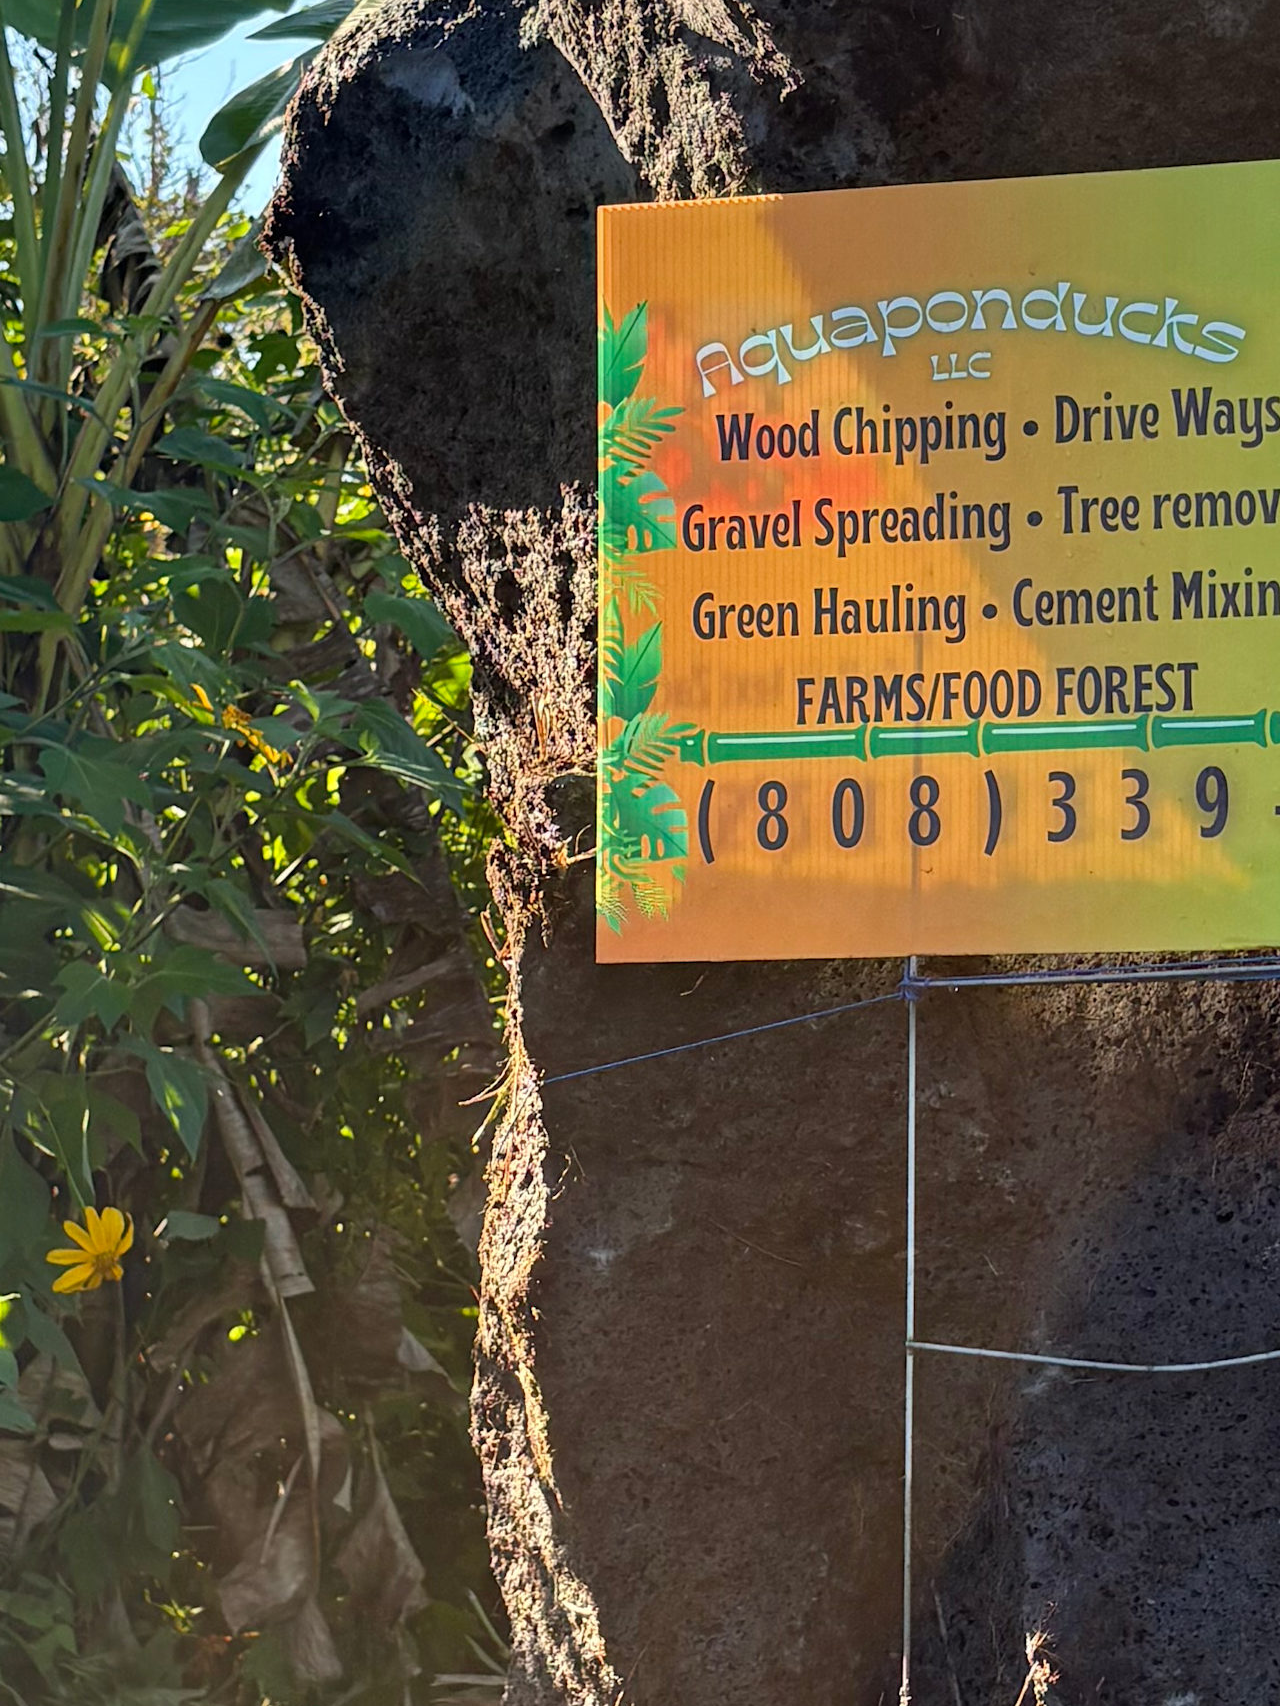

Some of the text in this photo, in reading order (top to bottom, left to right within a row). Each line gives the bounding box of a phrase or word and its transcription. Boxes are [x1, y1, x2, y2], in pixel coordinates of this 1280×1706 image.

[695, 281, 1246, 398] Aquaponducks
[930, 351, 992, 381] LLC
[715, 409, 820, 461] Wood
[833, 400, 1007, 466] Chipping
[1055, 391, 1160, 444] Drive
[682, 500, 801, 552] Gravel
[814, 490, 1011, 557] Spreading
[1057, 485, 1140, 535] Tree
[692, 592, 799, 640] Green
[814, 583, 966, 644] Hauling
[1013, 574, 1159, 627] Cement
[796, 662, 1199, 725] FARMS/FOOD FOREST
